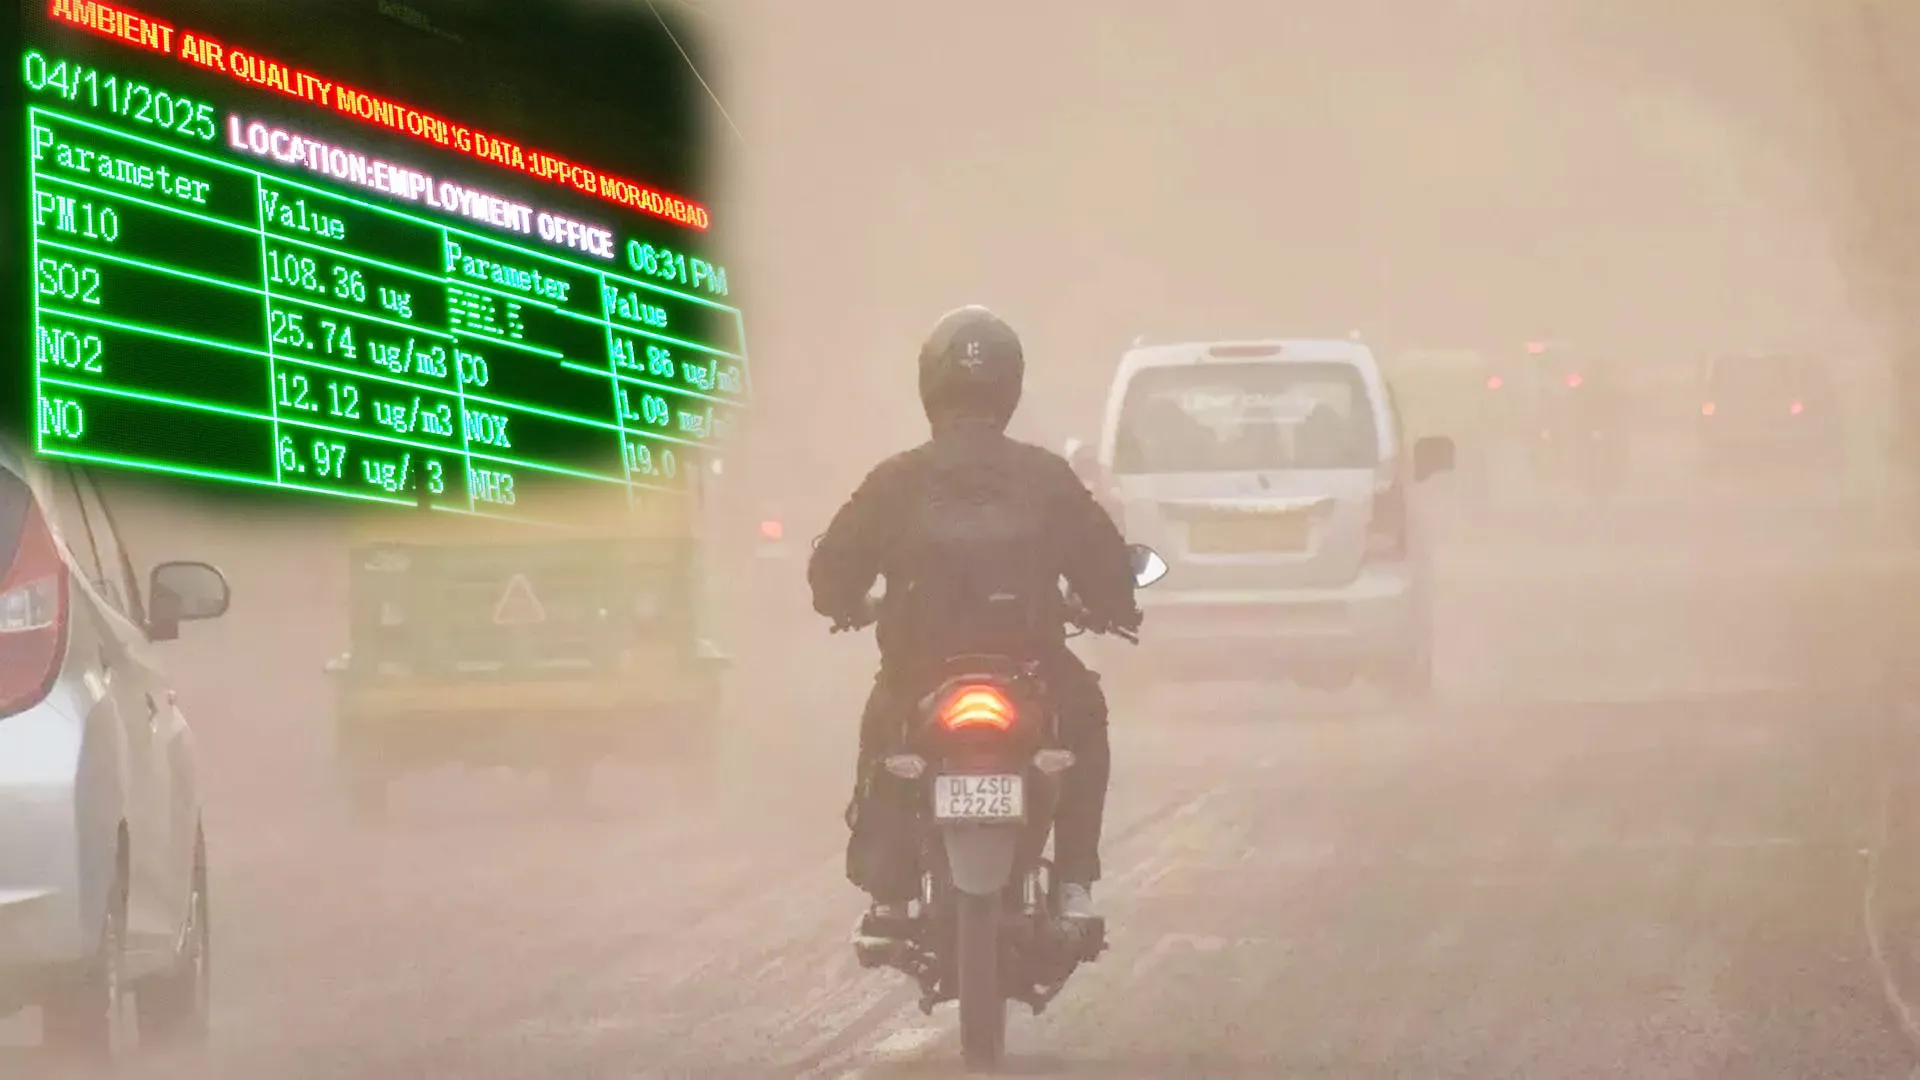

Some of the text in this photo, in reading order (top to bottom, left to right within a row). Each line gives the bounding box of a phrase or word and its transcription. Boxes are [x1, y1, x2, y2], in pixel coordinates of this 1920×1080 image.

[24, 52, 216, 141] 04/11/2025
[52, 0, 174, 53] AMBIENT
[182, 34, 226, 71] AIR
[230, 51, 331, 105] QUALITY
[475, 133, 525, 170] DATA
[600, 175, 708, 230] MORADABAD
[33, 125, 211, 203] Parameter
[229, 115, 615, 259] LOCATION:EMPLOYMENT OFFICE
[36, 190, 118, 242] PM10
[260, 188, 345, 241] Value
[39, 257, 101, 305] SO2
[268, 250, 412, 319] 108.36 ug
[446, 240, 571, 302] Parameter
[628, 239, 729, 297] 06:31 PM
[602, 284, 668, 328] Value
[39, 325, 103, 373] NO2
[270, 310, 447, 378] 25.74 ug/m3
[459, 351, 489, 387] CO
[612, 337, 675, 378] 41.86
[40, 396, 84, 439] NO
[277, 372, 453, 437] 12.12 ug/m3
[463, 409, 512, 449] NOX
[619, 389, 732, 439] 1.09 mg/
[280, 436, 347, 479] 6.97
[470, 467, 516, 506] NH3
[950, 796, 1012, 816] C2245
